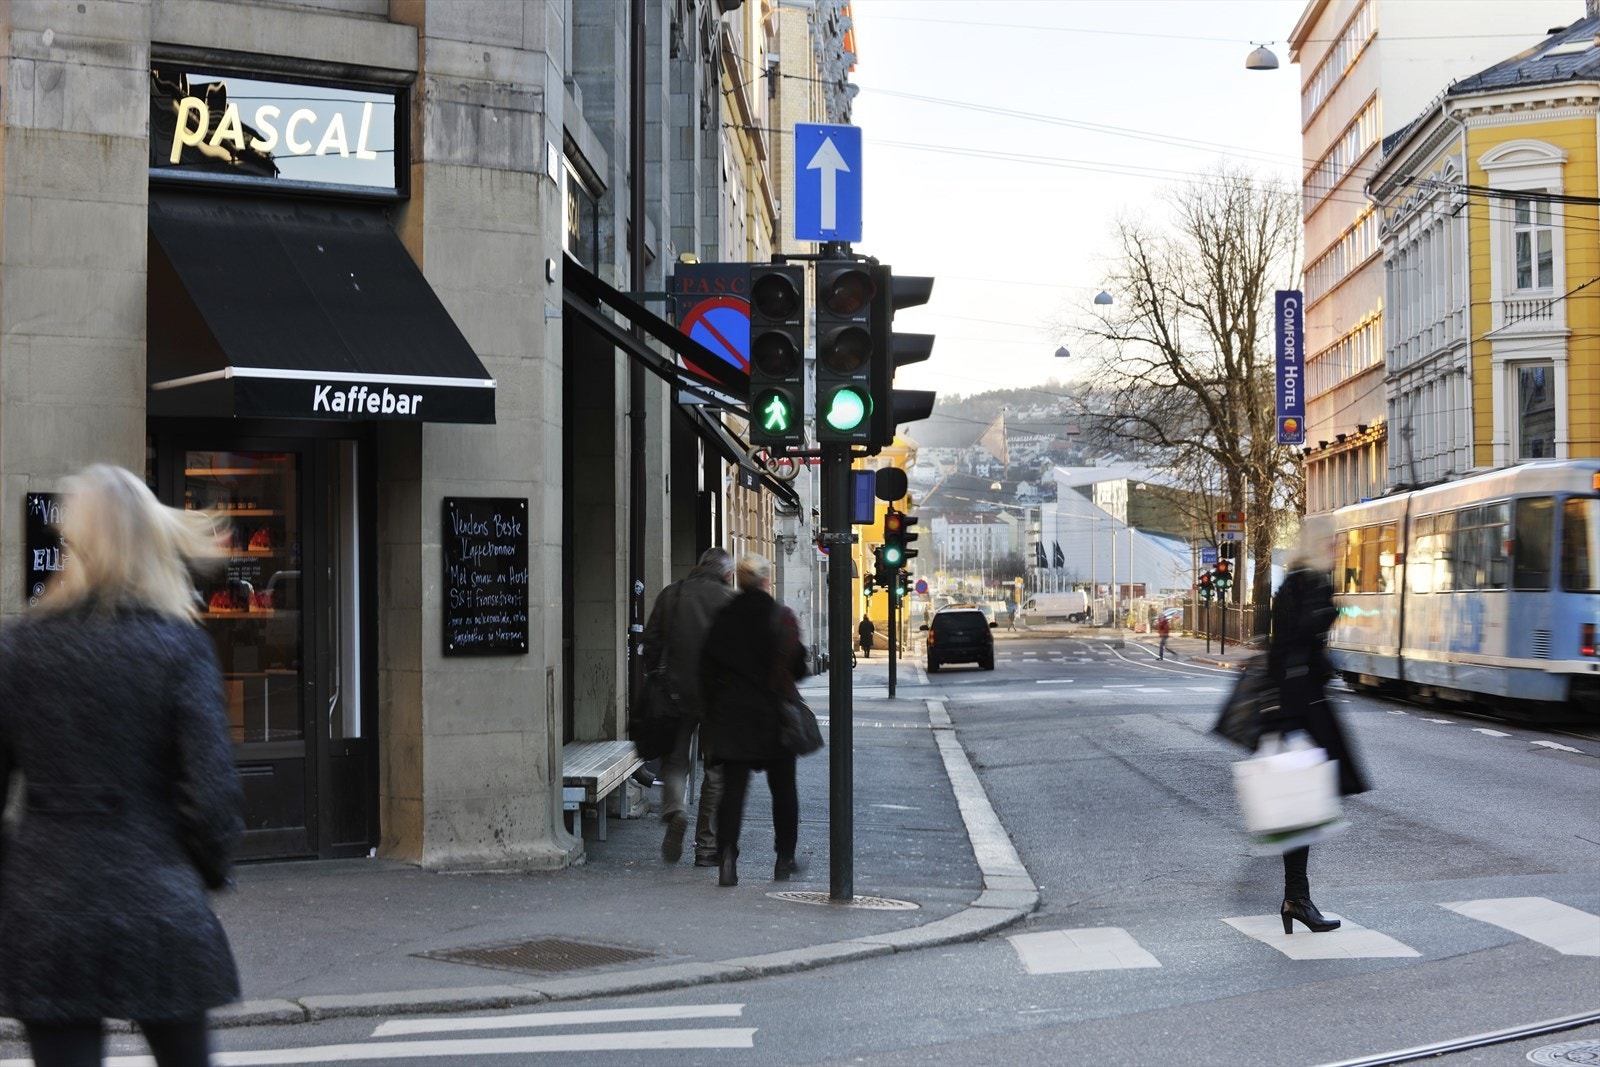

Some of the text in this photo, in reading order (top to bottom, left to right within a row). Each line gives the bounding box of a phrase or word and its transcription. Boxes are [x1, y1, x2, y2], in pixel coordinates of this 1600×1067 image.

[169, 96, 378, 165] PASCAL
[682, 276, 746, 294] PASC
[1283, 297, 1299, 411] COMFORT HOTEL
[312, 384, 424, 415] Kaffebar
[493, 513, 523, 538] Beste
